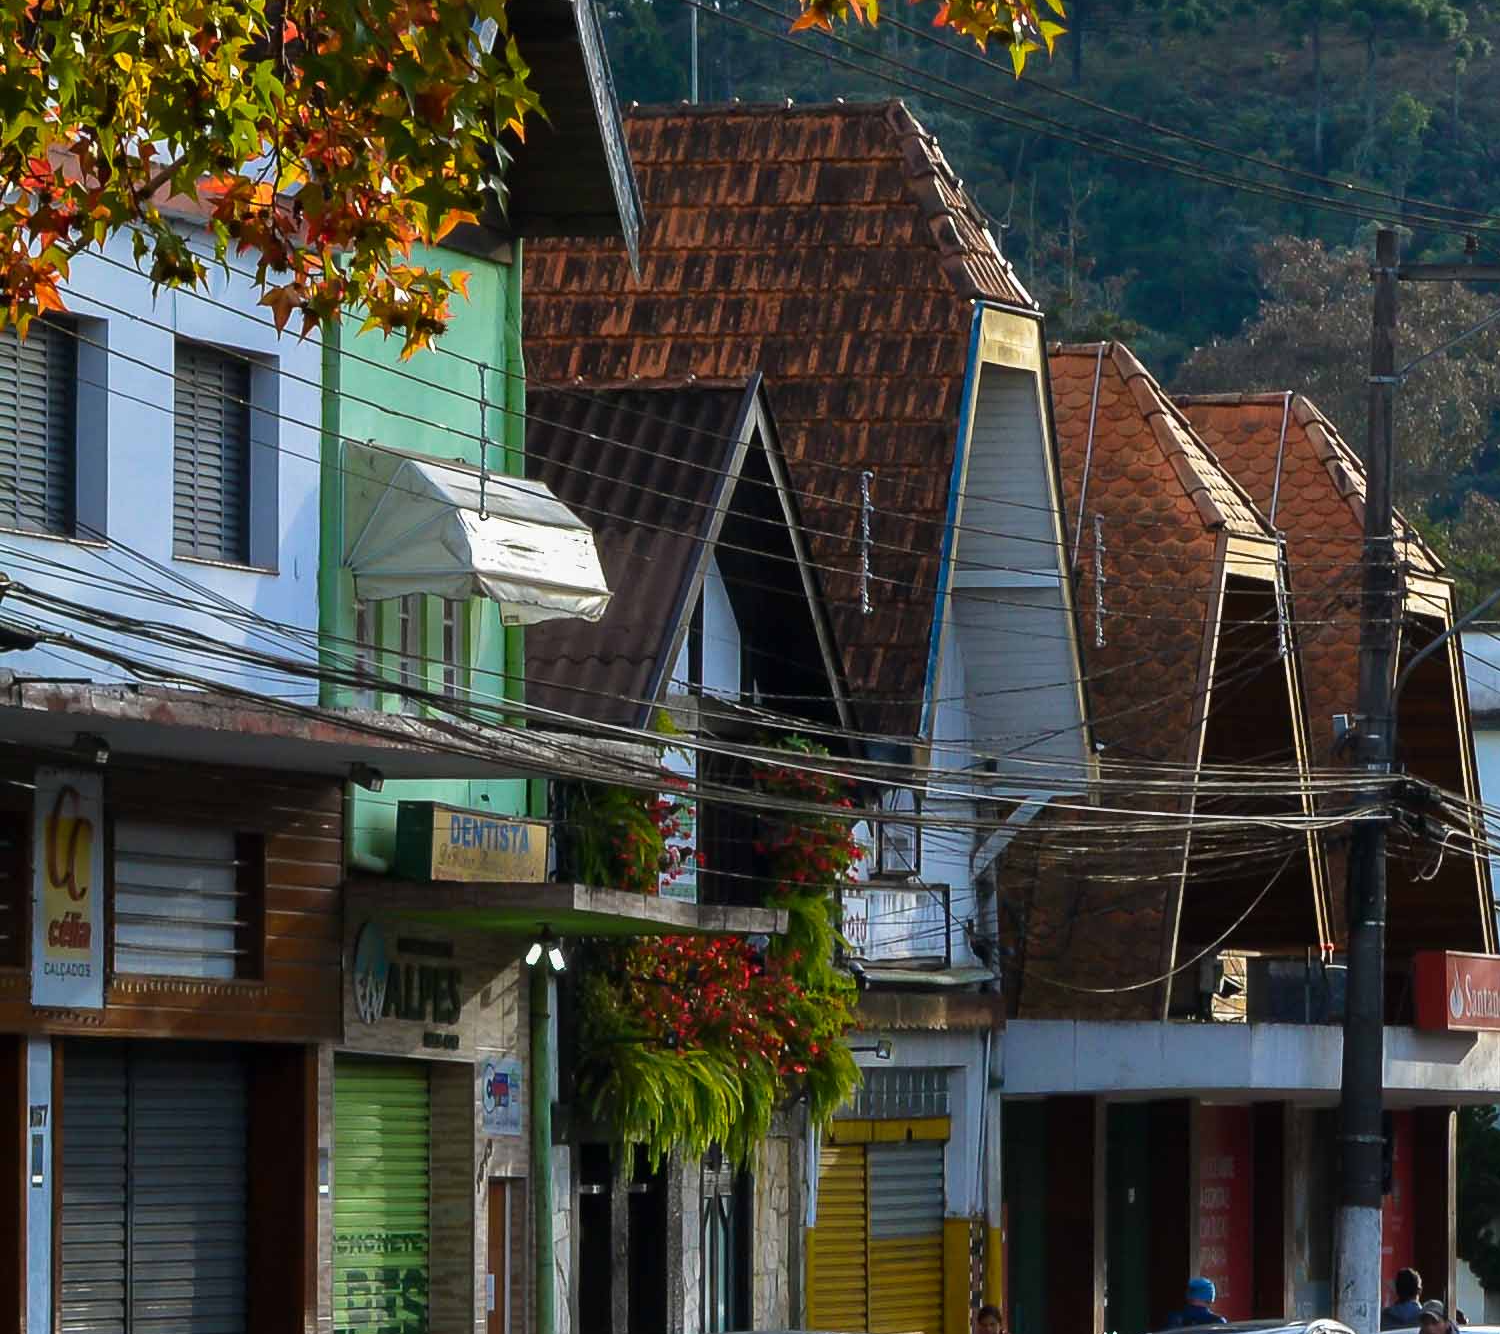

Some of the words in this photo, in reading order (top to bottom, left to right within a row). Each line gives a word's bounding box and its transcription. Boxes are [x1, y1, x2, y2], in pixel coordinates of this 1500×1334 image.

[450, 813, 530, 854] DENTISTA
[48, 912, 91, 949] célia
[43, 962, 91, 981] CALÇADOS
[381, 962, 462, 1025] ALPES
